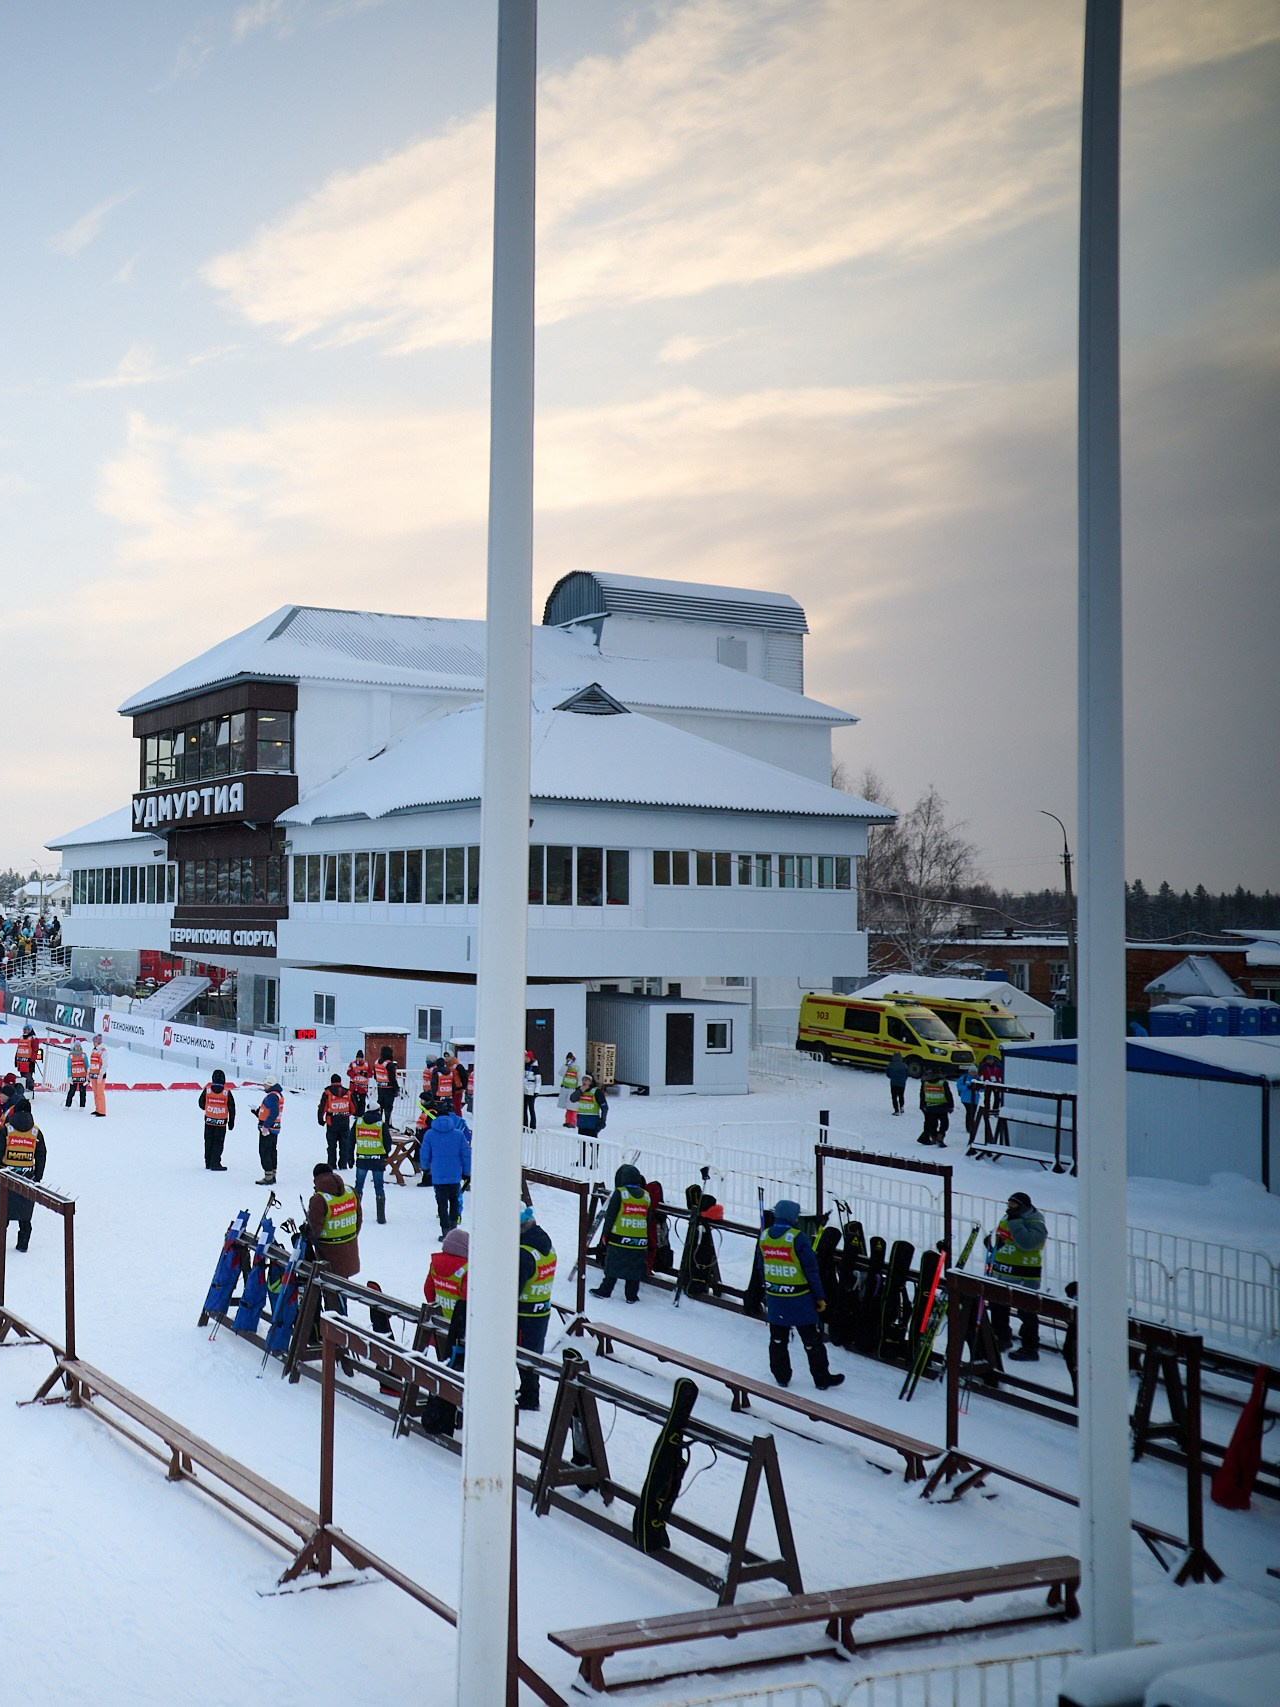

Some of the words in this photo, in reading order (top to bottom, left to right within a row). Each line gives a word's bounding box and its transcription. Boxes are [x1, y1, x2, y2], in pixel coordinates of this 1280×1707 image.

[133, 782, 244, 828] УДМУРТИЯ
[170, 928, 230, 945] ТЕРРИТОРИЯ
[234, 930, 277, 948] СПОРТА
[12, 996, 37, 1017] PARI
[56, 1004, 86, 1027] PARI
[816, 1011, 829, 1020] 103
[111, 1020, 145, 1036] ТЕХНОНИКОЛЬ
[174, 1033, 215, 1050] ТЕХНОНИКОЛЬ
[207, 1106, 226, 1114] СУДЬЯ
[621, 1218, 647, 1229] ТРЕНЕ
